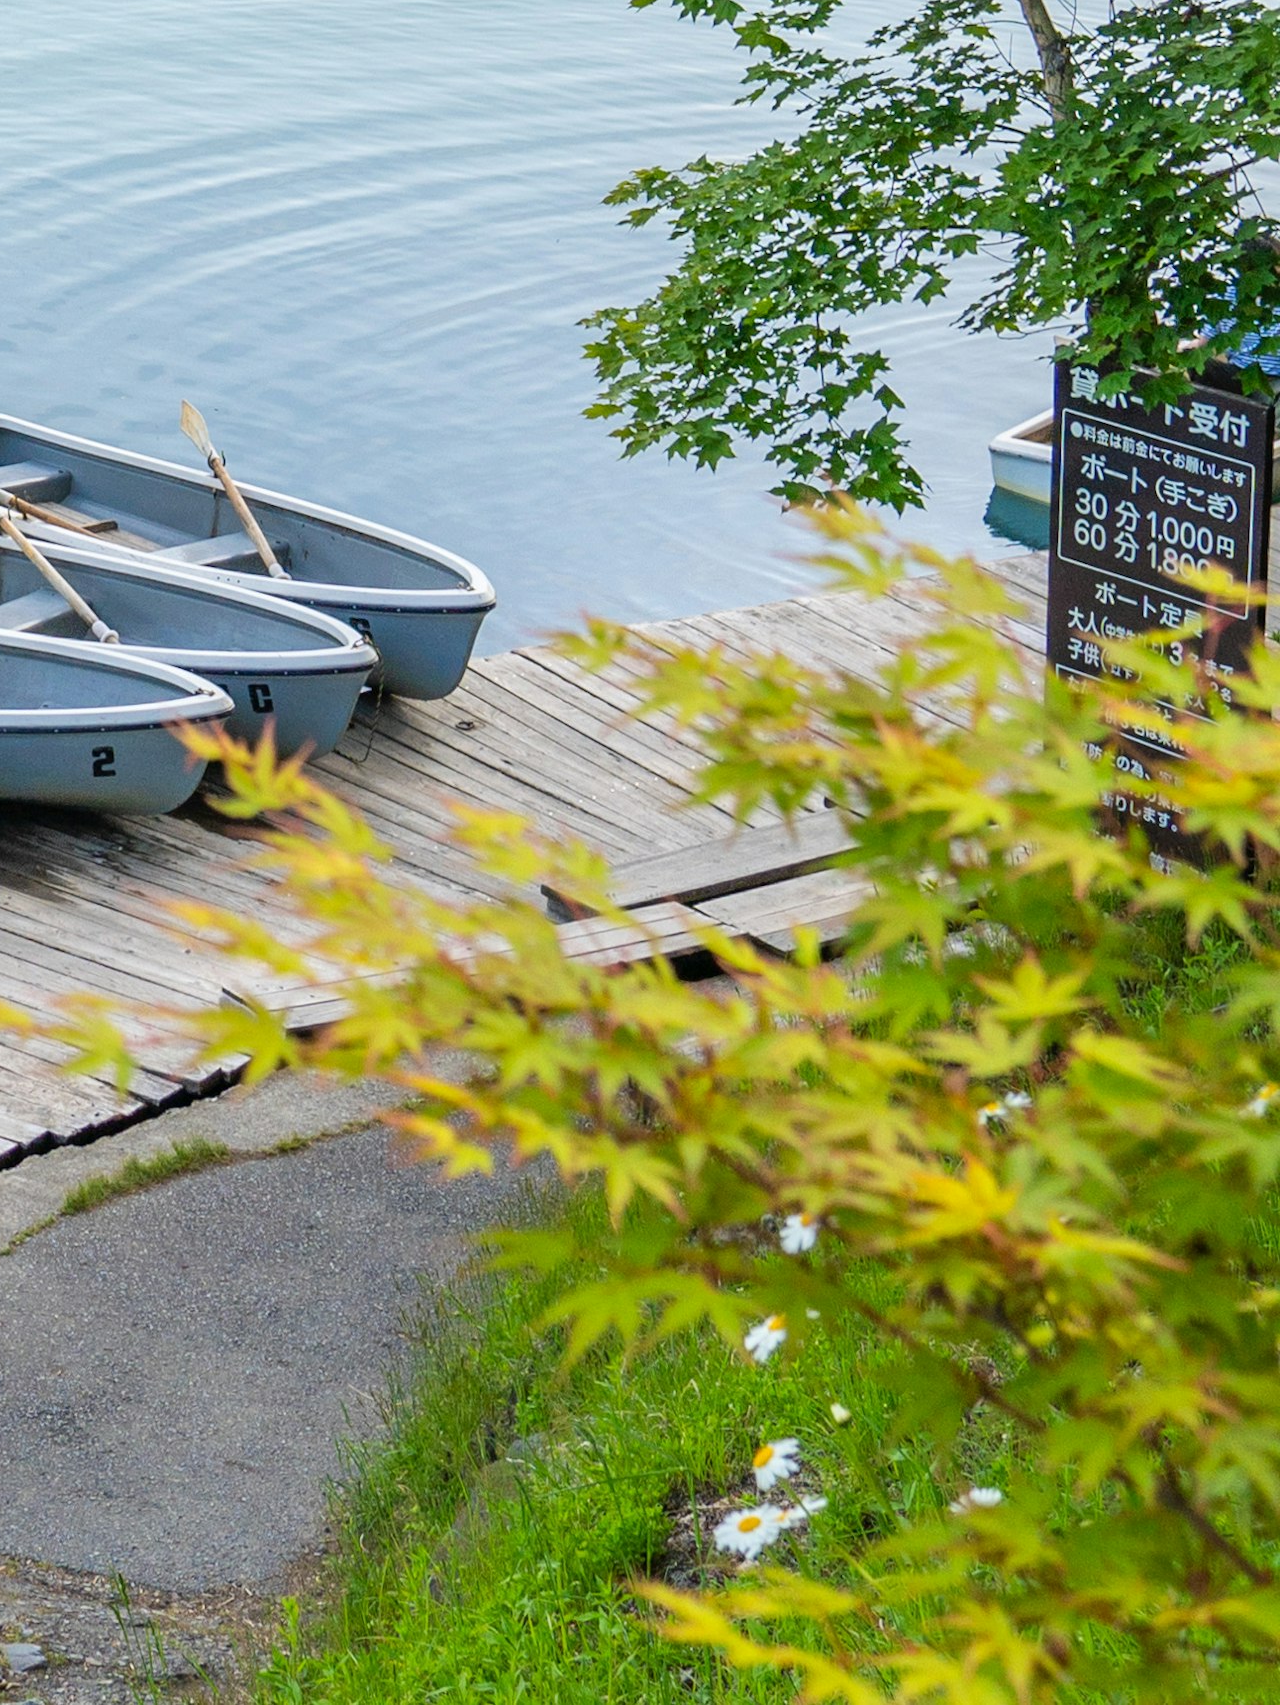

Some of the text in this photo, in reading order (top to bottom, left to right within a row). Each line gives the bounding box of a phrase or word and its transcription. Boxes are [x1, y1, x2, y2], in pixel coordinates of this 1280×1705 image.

[1083, 425, 1246, 487] 料金は前金にてお願いします
[92, 746, 117, 778] 2
